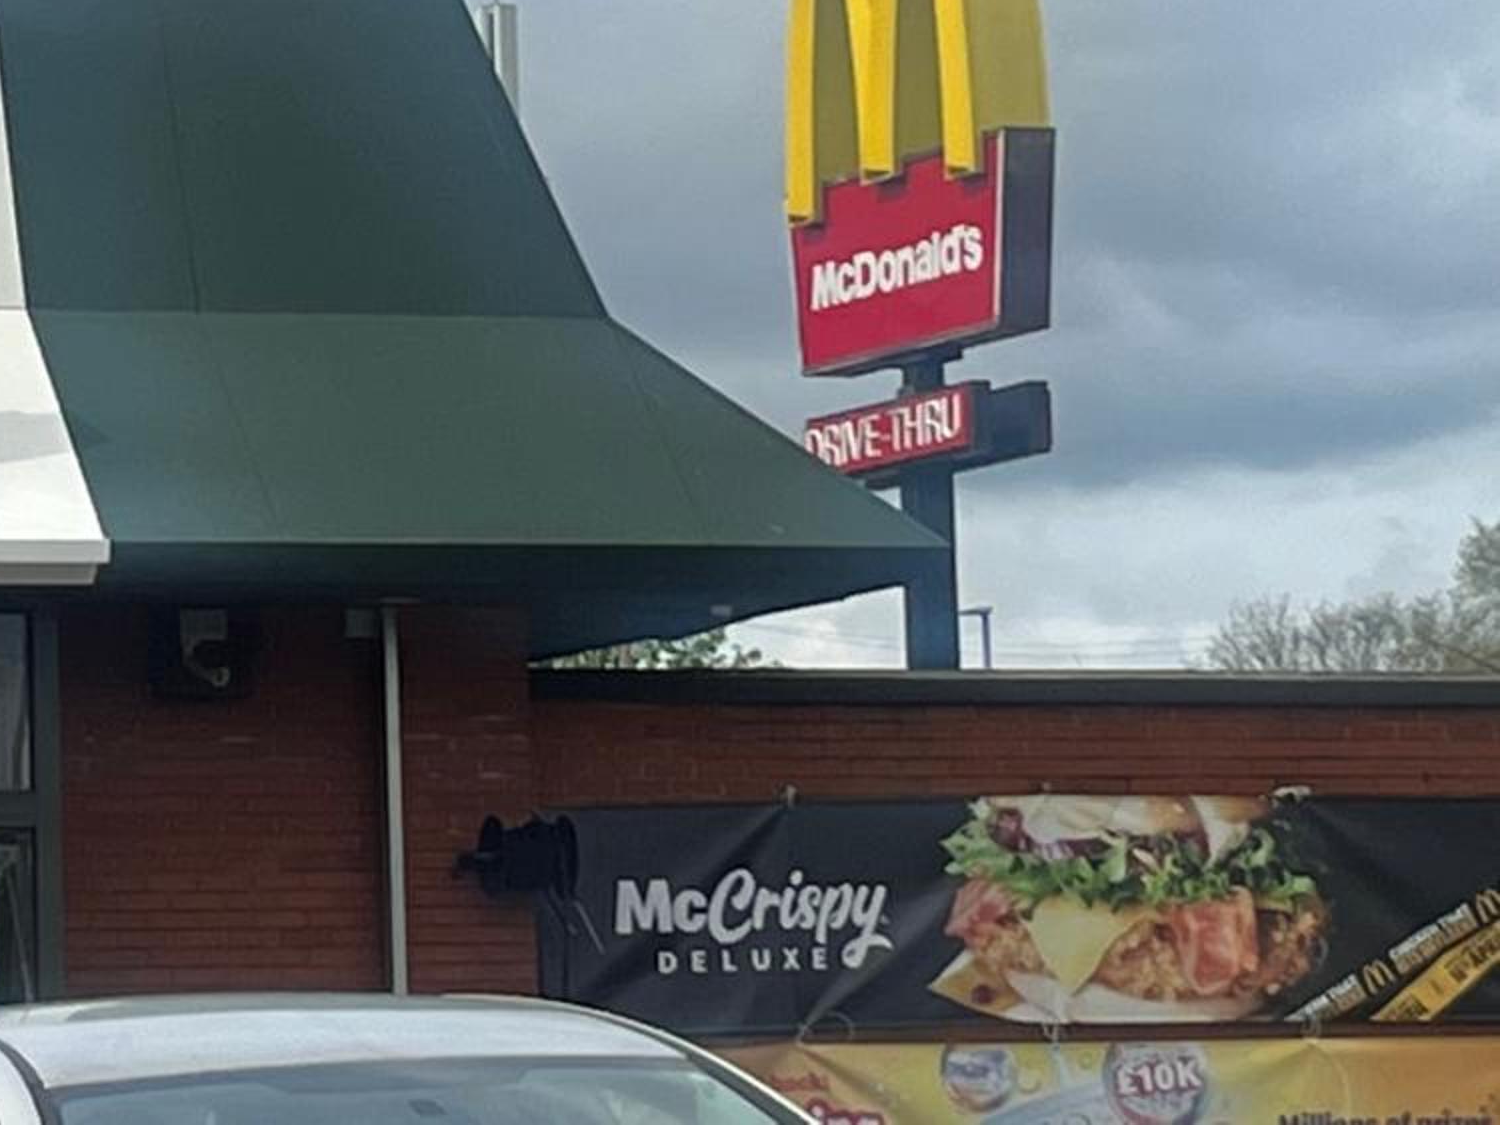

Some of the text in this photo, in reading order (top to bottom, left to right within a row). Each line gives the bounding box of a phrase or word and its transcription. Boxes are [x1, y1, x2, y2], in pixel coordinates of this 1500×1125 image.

[810, 223, 984, 312] McDonald's
[803, 392, 963, 468] DRIVE-THRU
[614, 867, 895, 969] McCrispy
[657, 947, 830, 974] DELUXE
